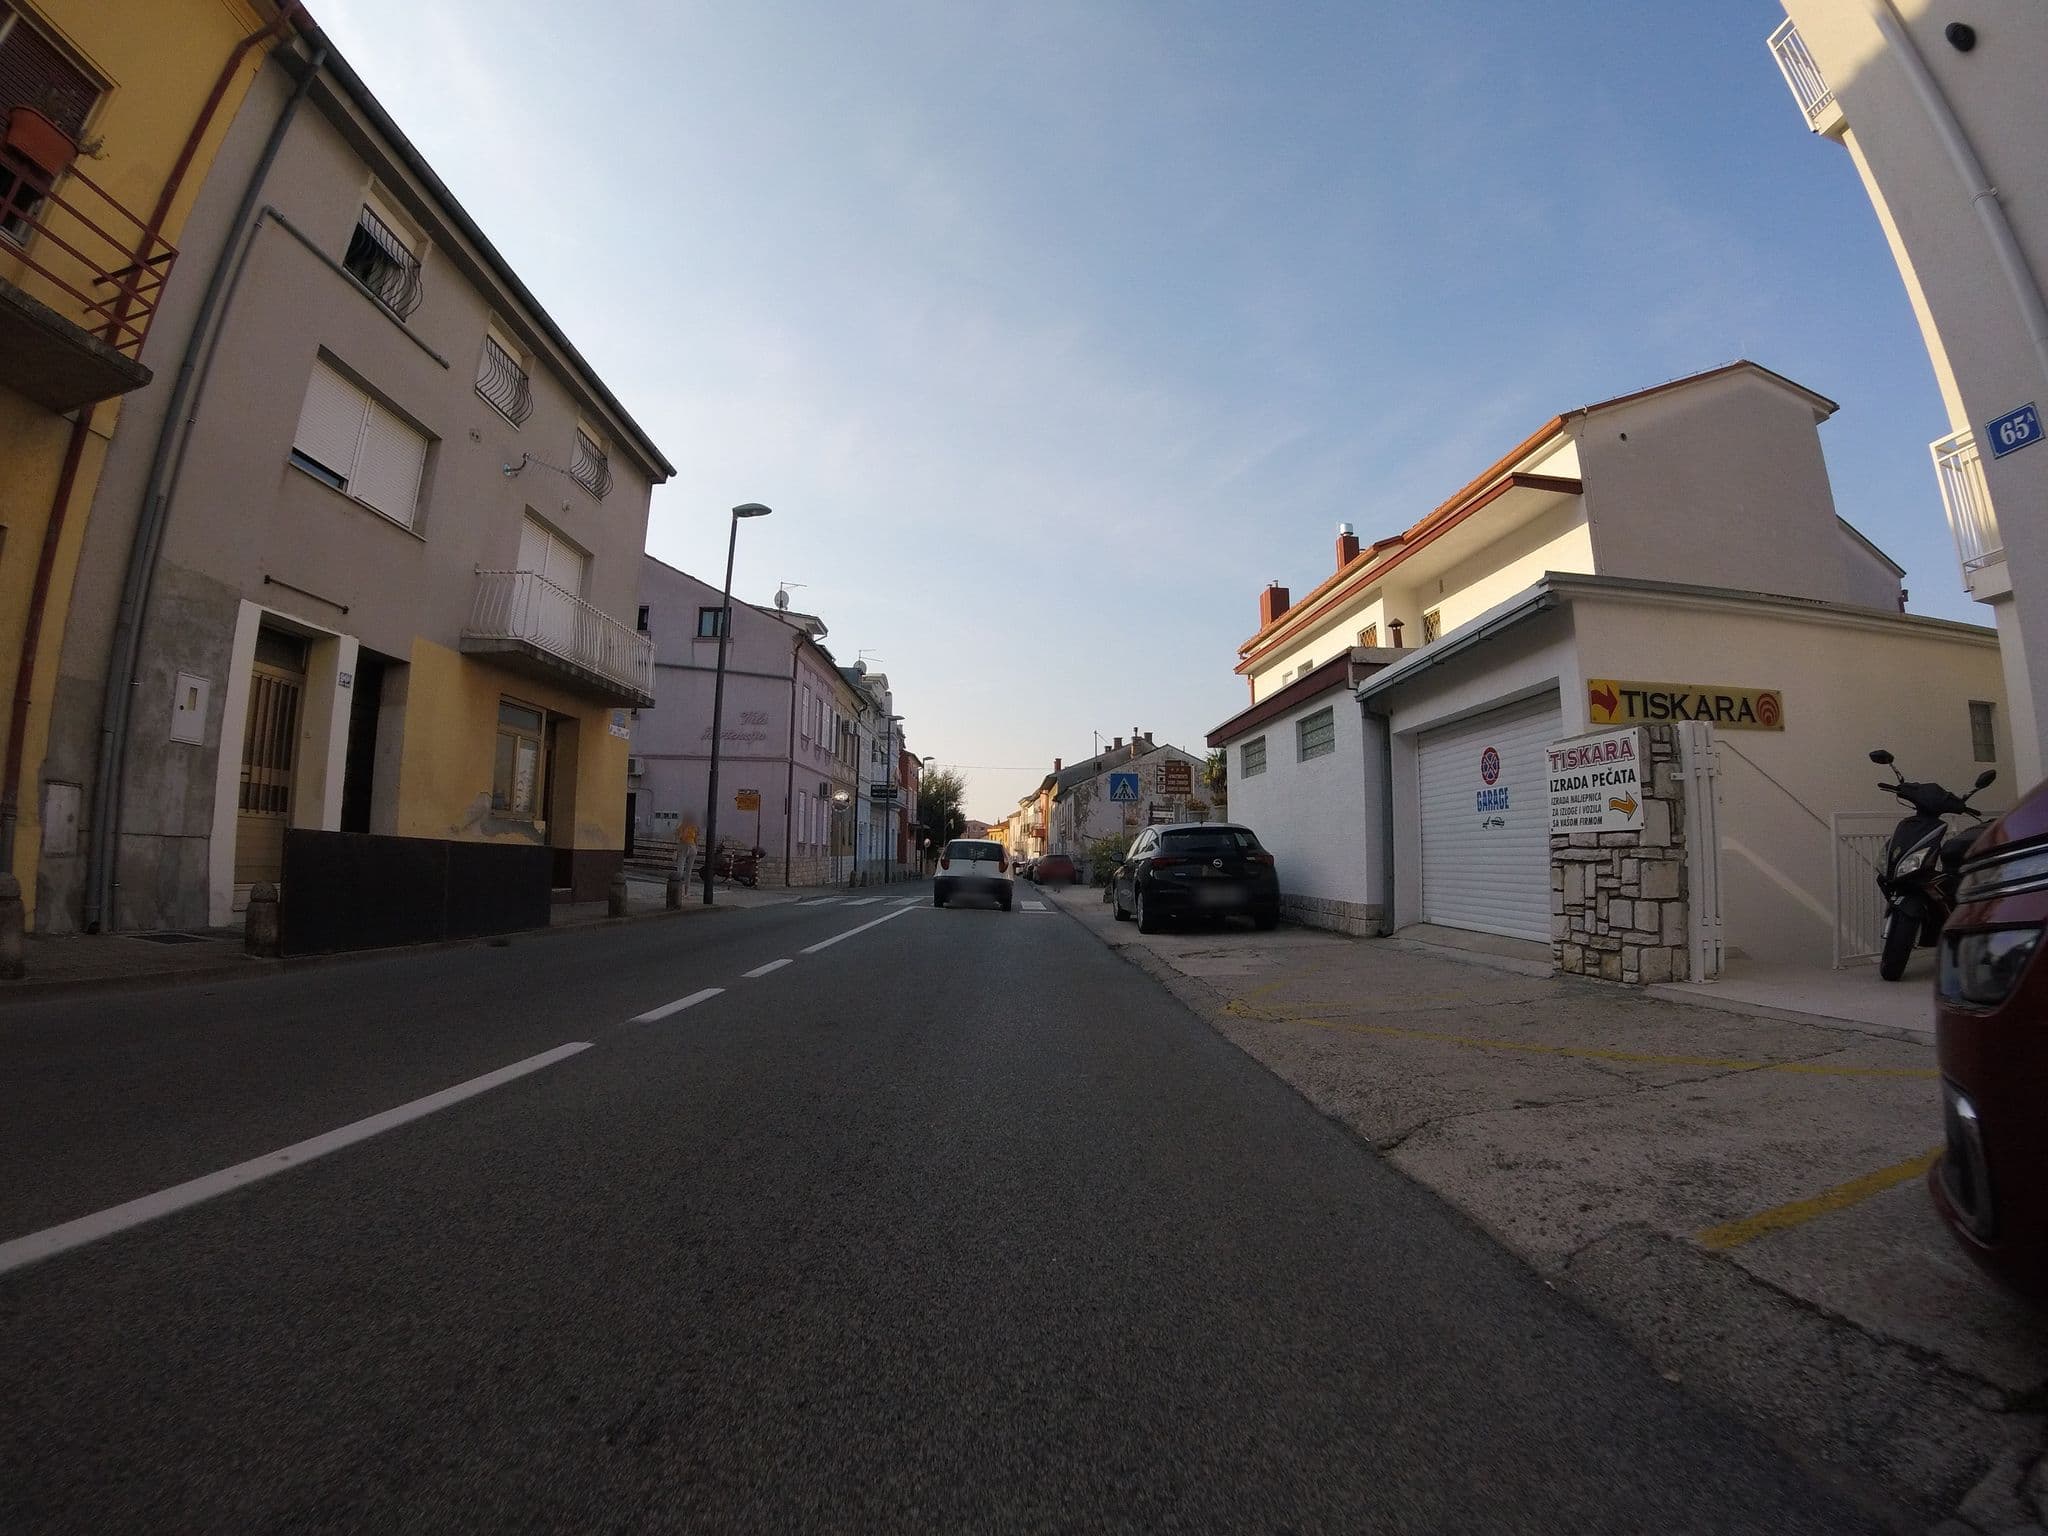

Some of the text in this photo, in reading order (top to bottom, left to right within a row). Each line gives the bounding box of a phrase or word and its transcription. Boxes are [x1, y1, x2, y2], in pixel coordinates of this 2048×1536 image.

[1619, 690, 1757, 723] TISKARA
[1549, 737, 1635, 773] TISKARA
[1550, 768, 1636, 793] IZRADA PEČATA
[1476, 787, 1509, 812] GARAGE
[1551, 795, 1569, 805] IZRADA
[1552, 808, 1560, 817] ZA
[1582, 804, 1601, 814] VOZILA
[1552, 819, 1560, 828] SA
[1579, 816, 1602, 825] FIRMOM
